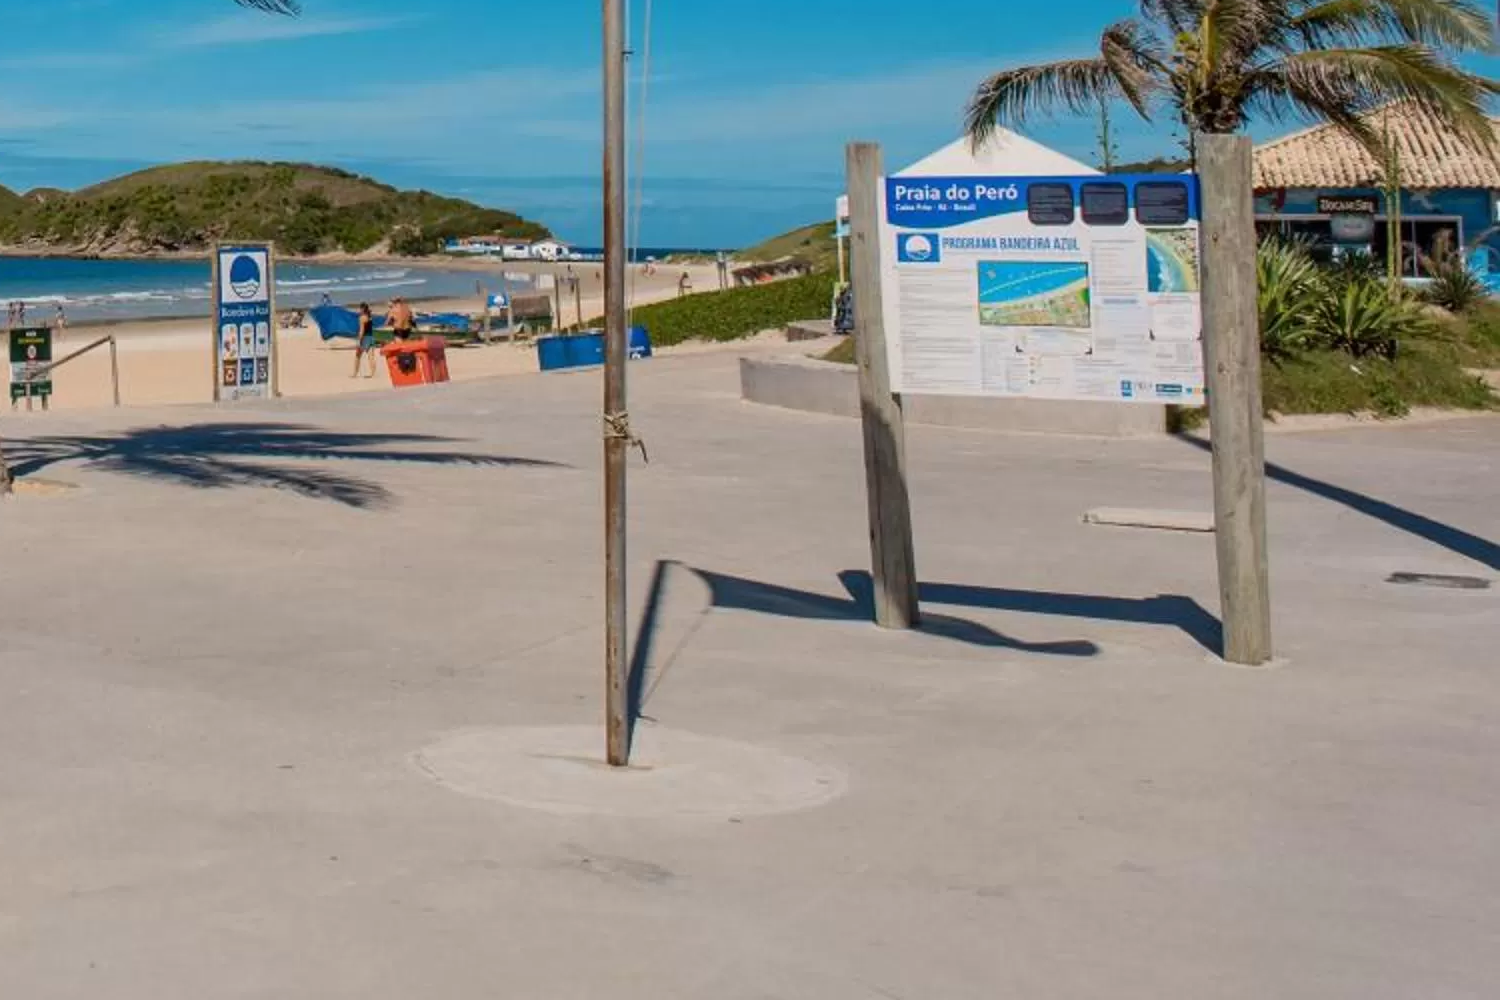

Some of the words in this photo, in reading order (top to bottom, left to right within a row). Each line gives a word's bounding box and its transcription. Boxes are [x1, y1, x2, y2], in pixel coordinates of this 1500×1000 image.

[895, 185, 941, 200] Praia
[946, 184, 970, 200] do
[975, 184, 1019, 200] Peró
[943, 236, 997, 249] PROGRAMA
[1000, 236, 1051, 250] BANDEIRA
[1054, 237, 1081, 251] AZUL
